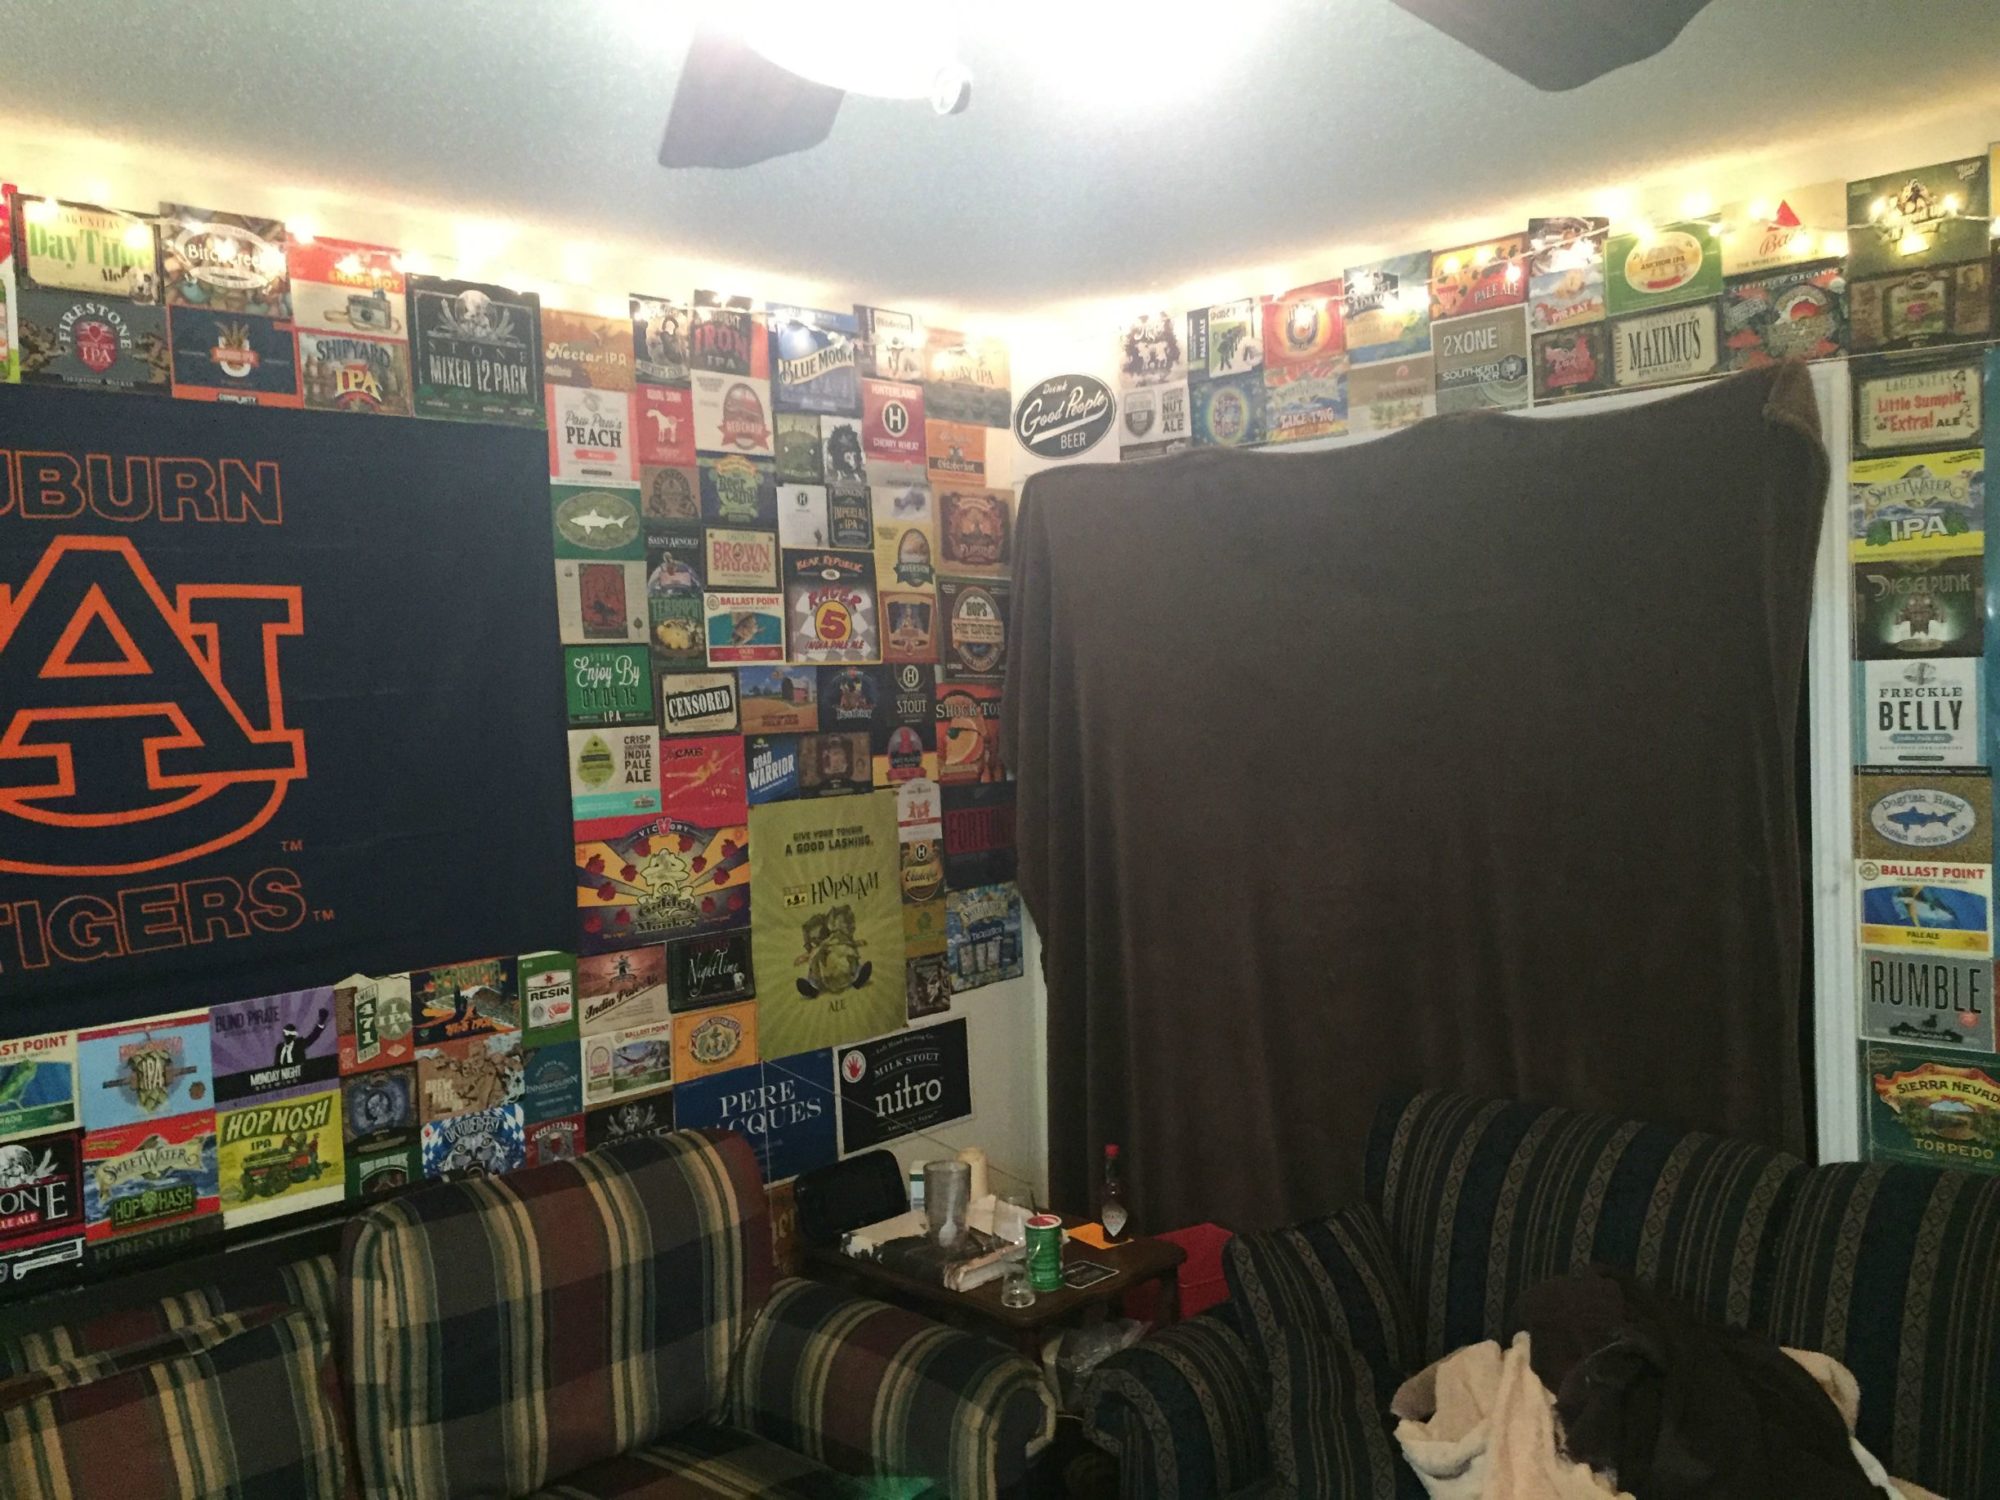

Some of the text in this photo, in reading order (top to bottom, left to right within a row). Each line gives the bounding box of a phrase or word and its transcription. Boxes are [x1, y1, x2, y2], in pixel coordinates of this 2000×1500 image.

[58, 302, 132, 350] FIRESTONE
[83, 346, 112, 364] IPA
[316, 339, 391, 369] SHIPYARD
[545, 341, 628, 367] Nectar IPA
[1628, 318, 1701, 371] MAXIMUS
[707, 355, 736, 369] IPA
[779, 346, 854, 385] BLUE MOON
[334, 369, 382, 402] IPA
[429, 354, 472, 388] MIXED
[475, 357, 492, 392] 12
[494, 361, 529, 395] PACK
[1042, 378, 1068, 395] Drink
[1020, 386, 1105, 437] Good People
[1162, 399, 1184, 413] NUT
[1877, 397, 1911, 414] Little
[1162, 418, 1185, 434] ALE
[1936, 416, 1961, 427] ALE
[566, 426, 622, 448] PEACH
[1059, 431, 1087, 449] BEER
[1890, 515, 1949, 542] IPA
[647, 534, 699, 549] SAINT ARNOLD
[713, 540, 771, 562] BROWN
[720, 596, 780, 607] BALLAST POINT
[820, 608, 848, 640] 5
[573, 654, 641, 689] Enjoy By
[1879, 686, 1963, 698] FRECKLE
[668, 688, 731, 719] CENSORED
[896, 699, 928, 715] STOUT
[935, 702, 977, 719] SHOCK
[603, 709, 622, 723] IPA
[1878, 700, 1963, 731] BELLY
[623, 735, 651, 746] CRISP
[624, 749, 652, 761] INDIA
[624, 759, 652, 771] PALE
[752, 750, 773, 769] ROAD
[625, 769, 652, 784] ALE
[748, 754, 795, 790] WARRIOR
[281, 840, 303, 852] TM
[785, 843, 793, 857] A
[796, 840, 825, 855] GOOD
[1880, 864, 1986, 880] BALLAST POINT
[312, 909, 336, 922] TM
[529, 986, 570, 1002] RESIN
[1870, 959, 1982, 1014] RUMBLE
[584, 994, 616, 1020] India
[214, 1005, 281, 1034] BLIND PIRATE
[23, 1034, 69, 1052] POINT
[249, 1064, 302, 1087] MONDAY NIGHT
[873, 1052, 940, 1078] MILK STOUT
[719, 1079, 796, 1119] PERE
[875, 1072, 942, 1118] nitro
[1895, 1078, 2000, 1105] SIERRA NEVAD
[226, 1099, 331, 1142] HOP NOSH
[251, 1138, 272, 1151] IPA
[1914, 1137, 1995, 1160] TORPEDO
[0, 1181, 68, 1221] ONE
[113, 1185, 194, 1221] HOP HASH
